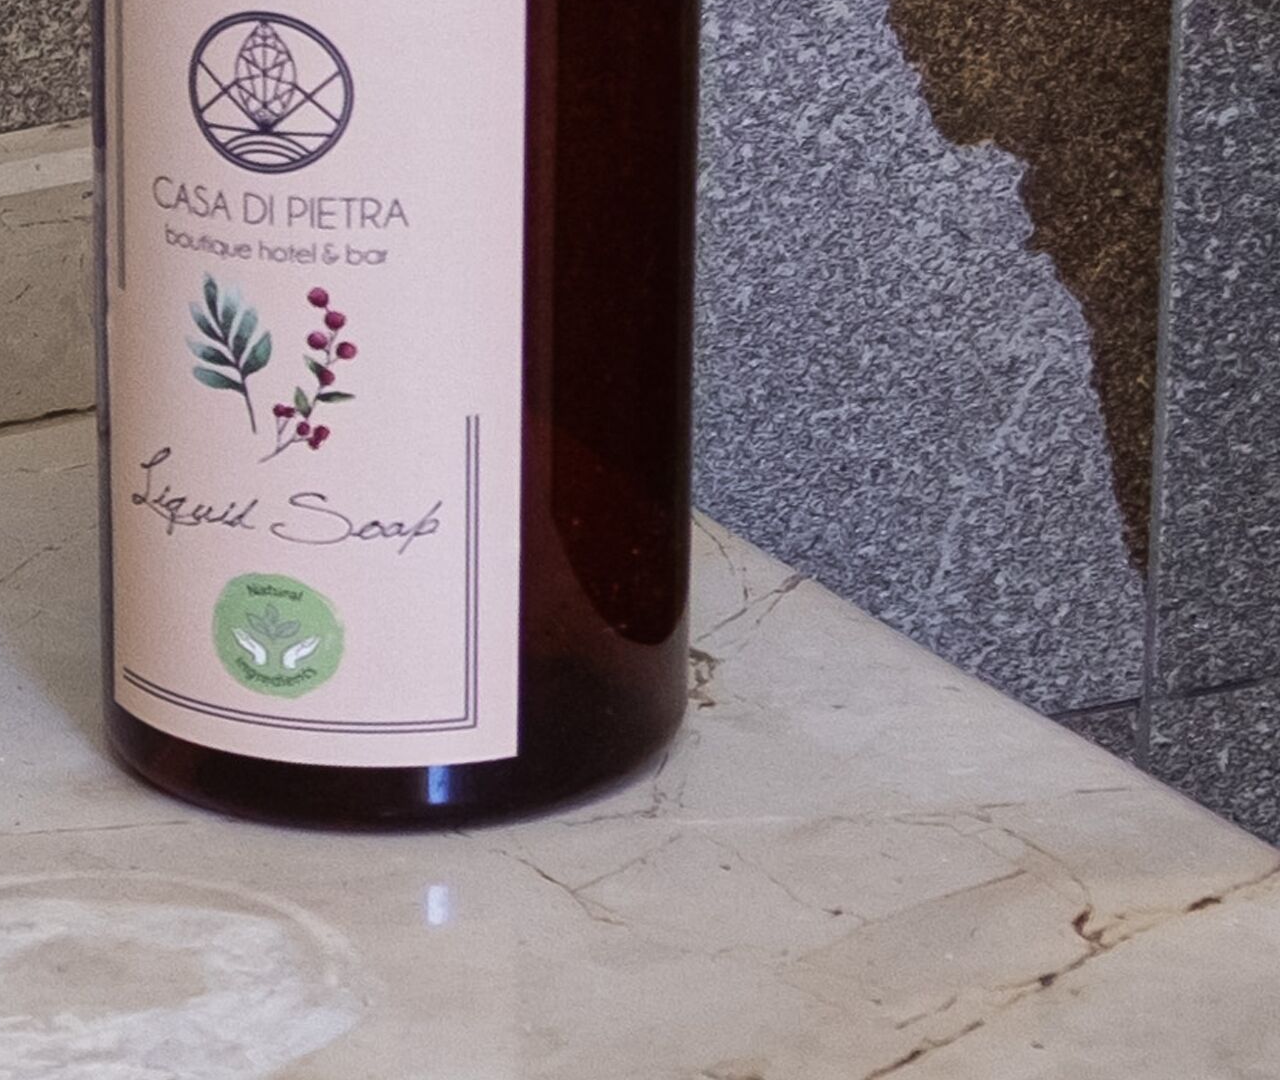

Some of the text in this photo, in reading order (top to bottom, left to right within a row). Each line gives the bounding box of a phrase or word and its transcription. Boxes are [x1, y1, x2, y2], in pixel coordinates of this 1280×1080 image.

[152, 176, 409, 229] CASA DI PIETRA
[164, 224, 389, 264] boutique hotel & bar
[132, 447, 443, 555] Liquid Soap
[246, 583, 304, 601] Natural
